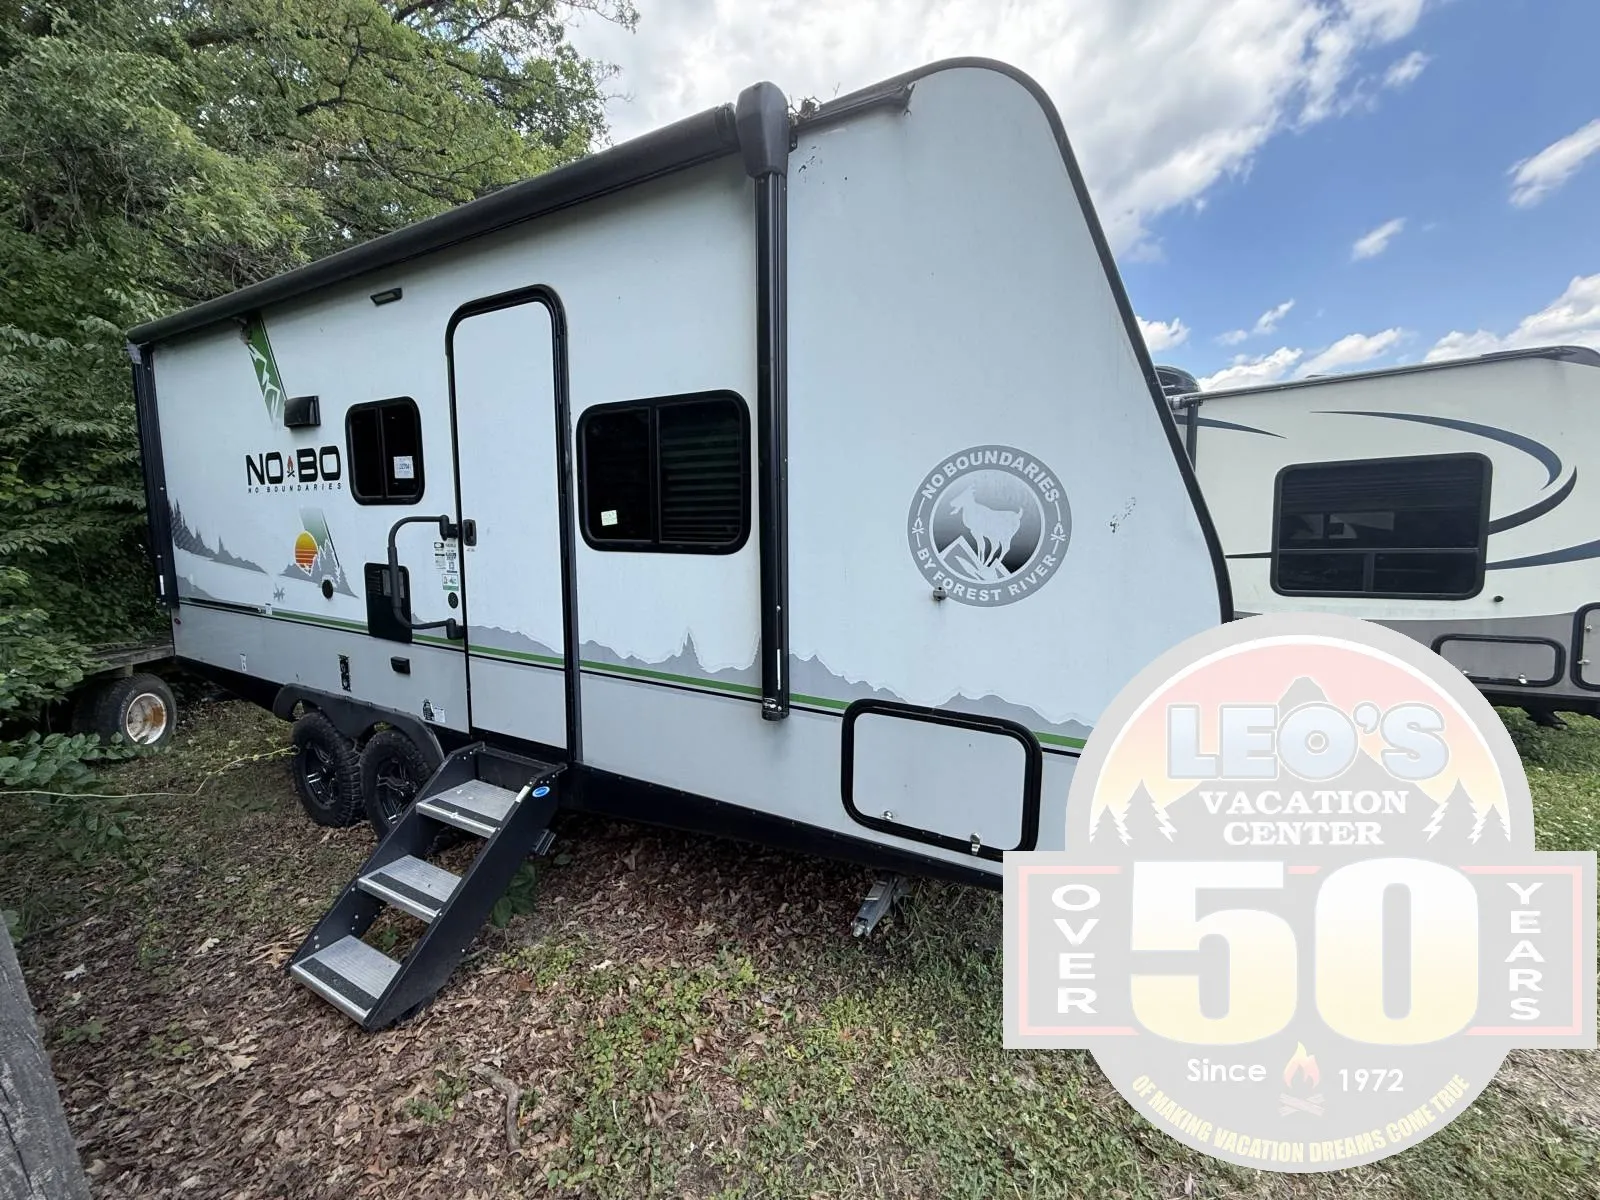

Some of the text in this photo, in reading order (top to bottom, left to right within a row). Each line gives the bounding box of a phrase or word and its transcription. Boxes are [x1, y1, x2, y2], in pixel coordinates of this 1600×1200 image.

[248, 482, 342, 494] NO BOUNDARIES
[921, 450, 1060, 503] NO BOUNDARIES
[917, 547, 1057, 601] BY FOREST RIVER
